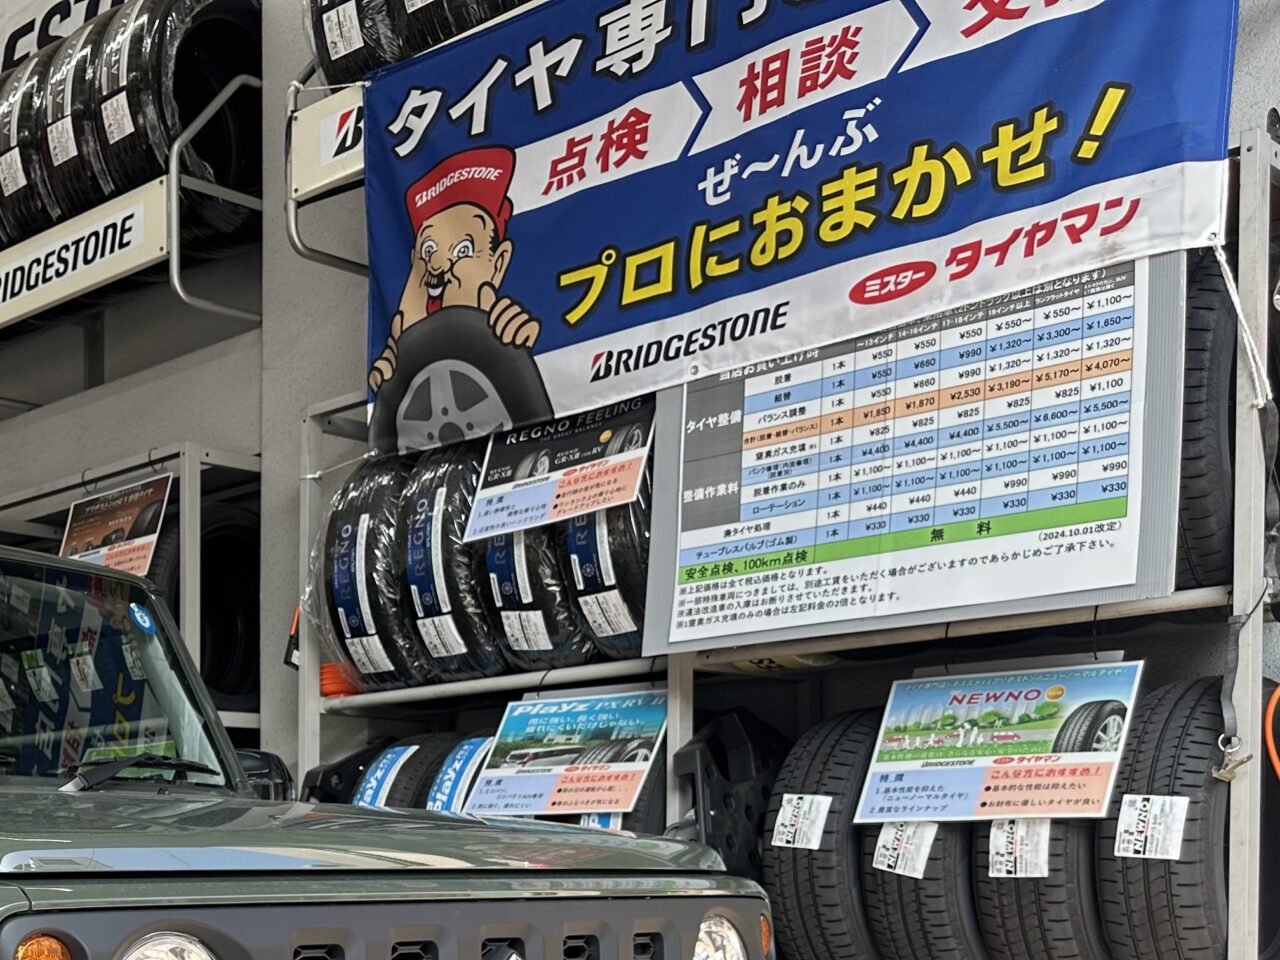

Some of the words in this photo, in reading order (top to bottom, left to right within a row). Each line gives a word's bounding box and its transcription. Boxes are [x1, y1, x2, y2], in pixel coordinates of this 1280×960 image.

[735, 23, 864, 123] 相談
[541, 107, 652, 196] 点検
[415, 166, 503, 208] BRIDGESTONE
[863, 269, 926, 298] ミスター
[943, 197, 1141, 282] タイヤマン
[589, 300, 790, 384] BRIDGESTONE
[832, 360, 846, 371] 1本
[872, 349, 893, 360] ¥550
[914, 338, 937, 350] ¥550
[959, 328, 983, 340] ¥550
[832, 379, 845, 389] 1本
[871, 368, 892, 379] ¥550
[913, 358, 936, 369] ¥660
[959, 348, 982, 359] ¥990
[506, 420, 570, 445] REGNO
[576, 398, 642, 427] FEELING
[686, 409, 742, 434] タイヤ整備
[831, 398, 845, 408] 1本
[871, 387, 892, 398] ¥550
[913, 378, 936, 389] ¥660
[958, 368, 981, 379] ¥990
[829, 436, 843, 446] 1本
[869, 426, 890, 437] ¥825
[912, 417, 934, 428] ¥825
[957, 408, 980, 419] ¥825
[1007, 398, 1030, 409] ¥825
[1055, 387, 1080, 399] ¥825
[1089, 378, 1124, 392] ¥1,100
[830, 417, 844, 427] 1本
[863, 406, 891, 419] ¥1,650
[905, 397, 935, 410] ¥1,870
[950, 388, 981, 401] ¥2,530
[829, 454, 842, 464] 1本
[861, 444, 890, 457] ¥4,400
[904, 436, 934, 449] ¥4,400
[949, 427, 979, 440] ¥4,400
[826, 510, 840, 520] 1本
[866, 501, 887, 512] ¥440
[909, 494, 931, 504] ¥440
[953, 487, 977, 498] ¥440
[1003, 478, 1028, 489] ¥990
[1052, 469, 1077, 480] ¥990
[1102, 460, 1127, 472] ¥990
[828, 473, 842, 483] 1本
[752, 498, 806, 514] ローテーション
[828, 491, 841, 501] 1本
[826, 528, 839, 538] 1本
[865, 521, 886, 532] ¥330
[907, 513, 930, 524] ¥330
[953, 506, 976, 517] ¥330
[1003, 498, 1027, 509] ¥330
[1051, 490, 1076, 501] ¥330
[1101, 481, 1127, 493] ¥330
[414, 498, 428, 577] REGNO
[339, 524, 352, 600] REGNO
[685, 549, 809, 580] 安全点検、100km点検
[949, 689, 1041, 706] NEWNO
[921, 759, 975, 769] BRIDGESTONE
[1016, 755, 1061, 765] タイヤマン
[786, 799, 803, 844] NEWNO
[1133, 800, 1150, 850] NEWNO
[1006, 822, 1015, 871] NEWNO
